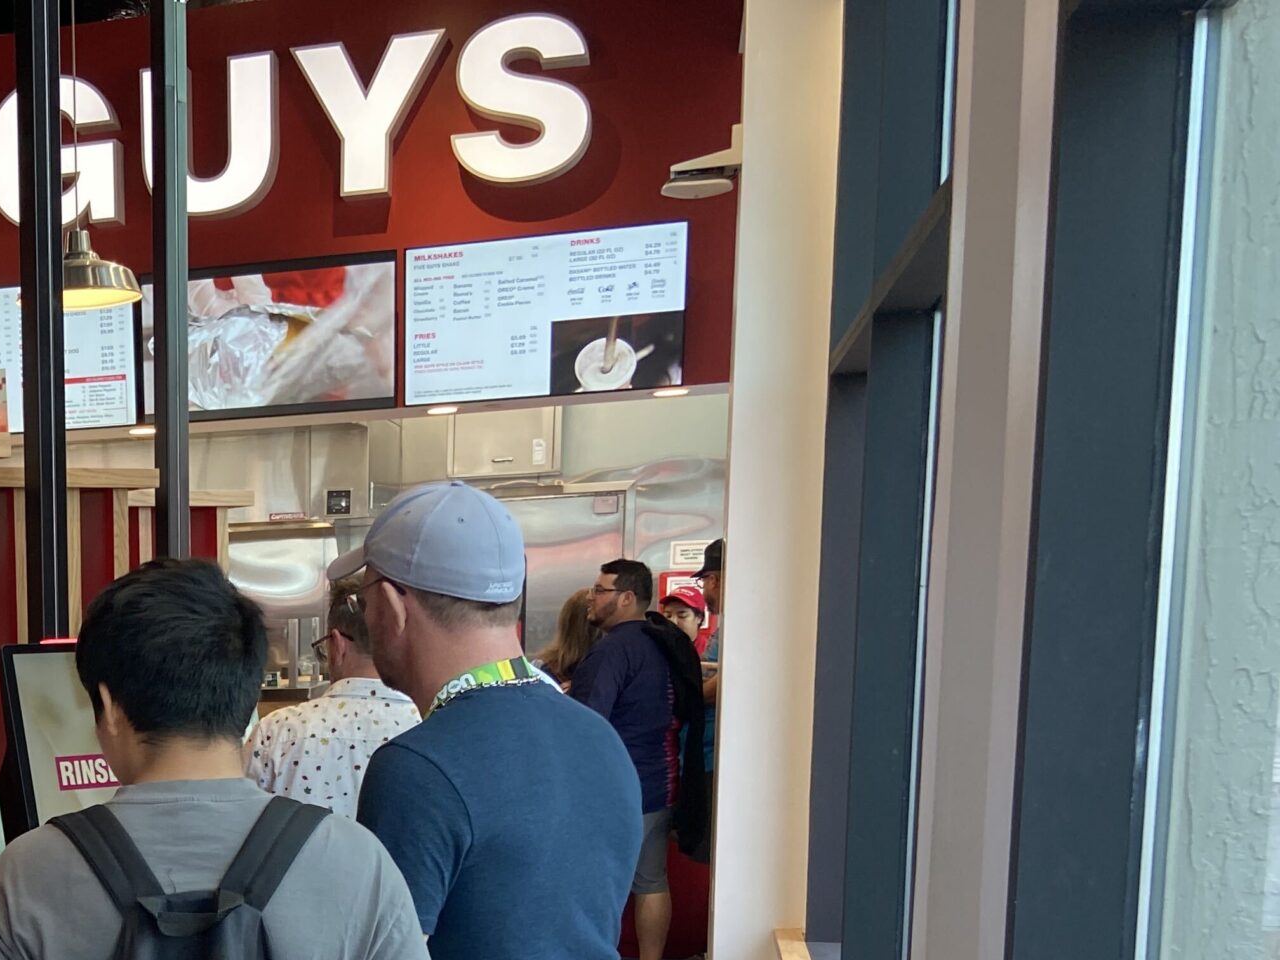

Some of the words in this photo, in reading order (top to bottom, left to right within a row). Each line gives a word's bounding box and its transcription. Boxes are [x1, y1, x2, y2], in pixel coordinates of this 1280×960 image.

[570, 238, 601, 247] DRINKS
[414, 251, 464, 262] MILKSHAKES
[414, 333, 437, 341] FRIES
